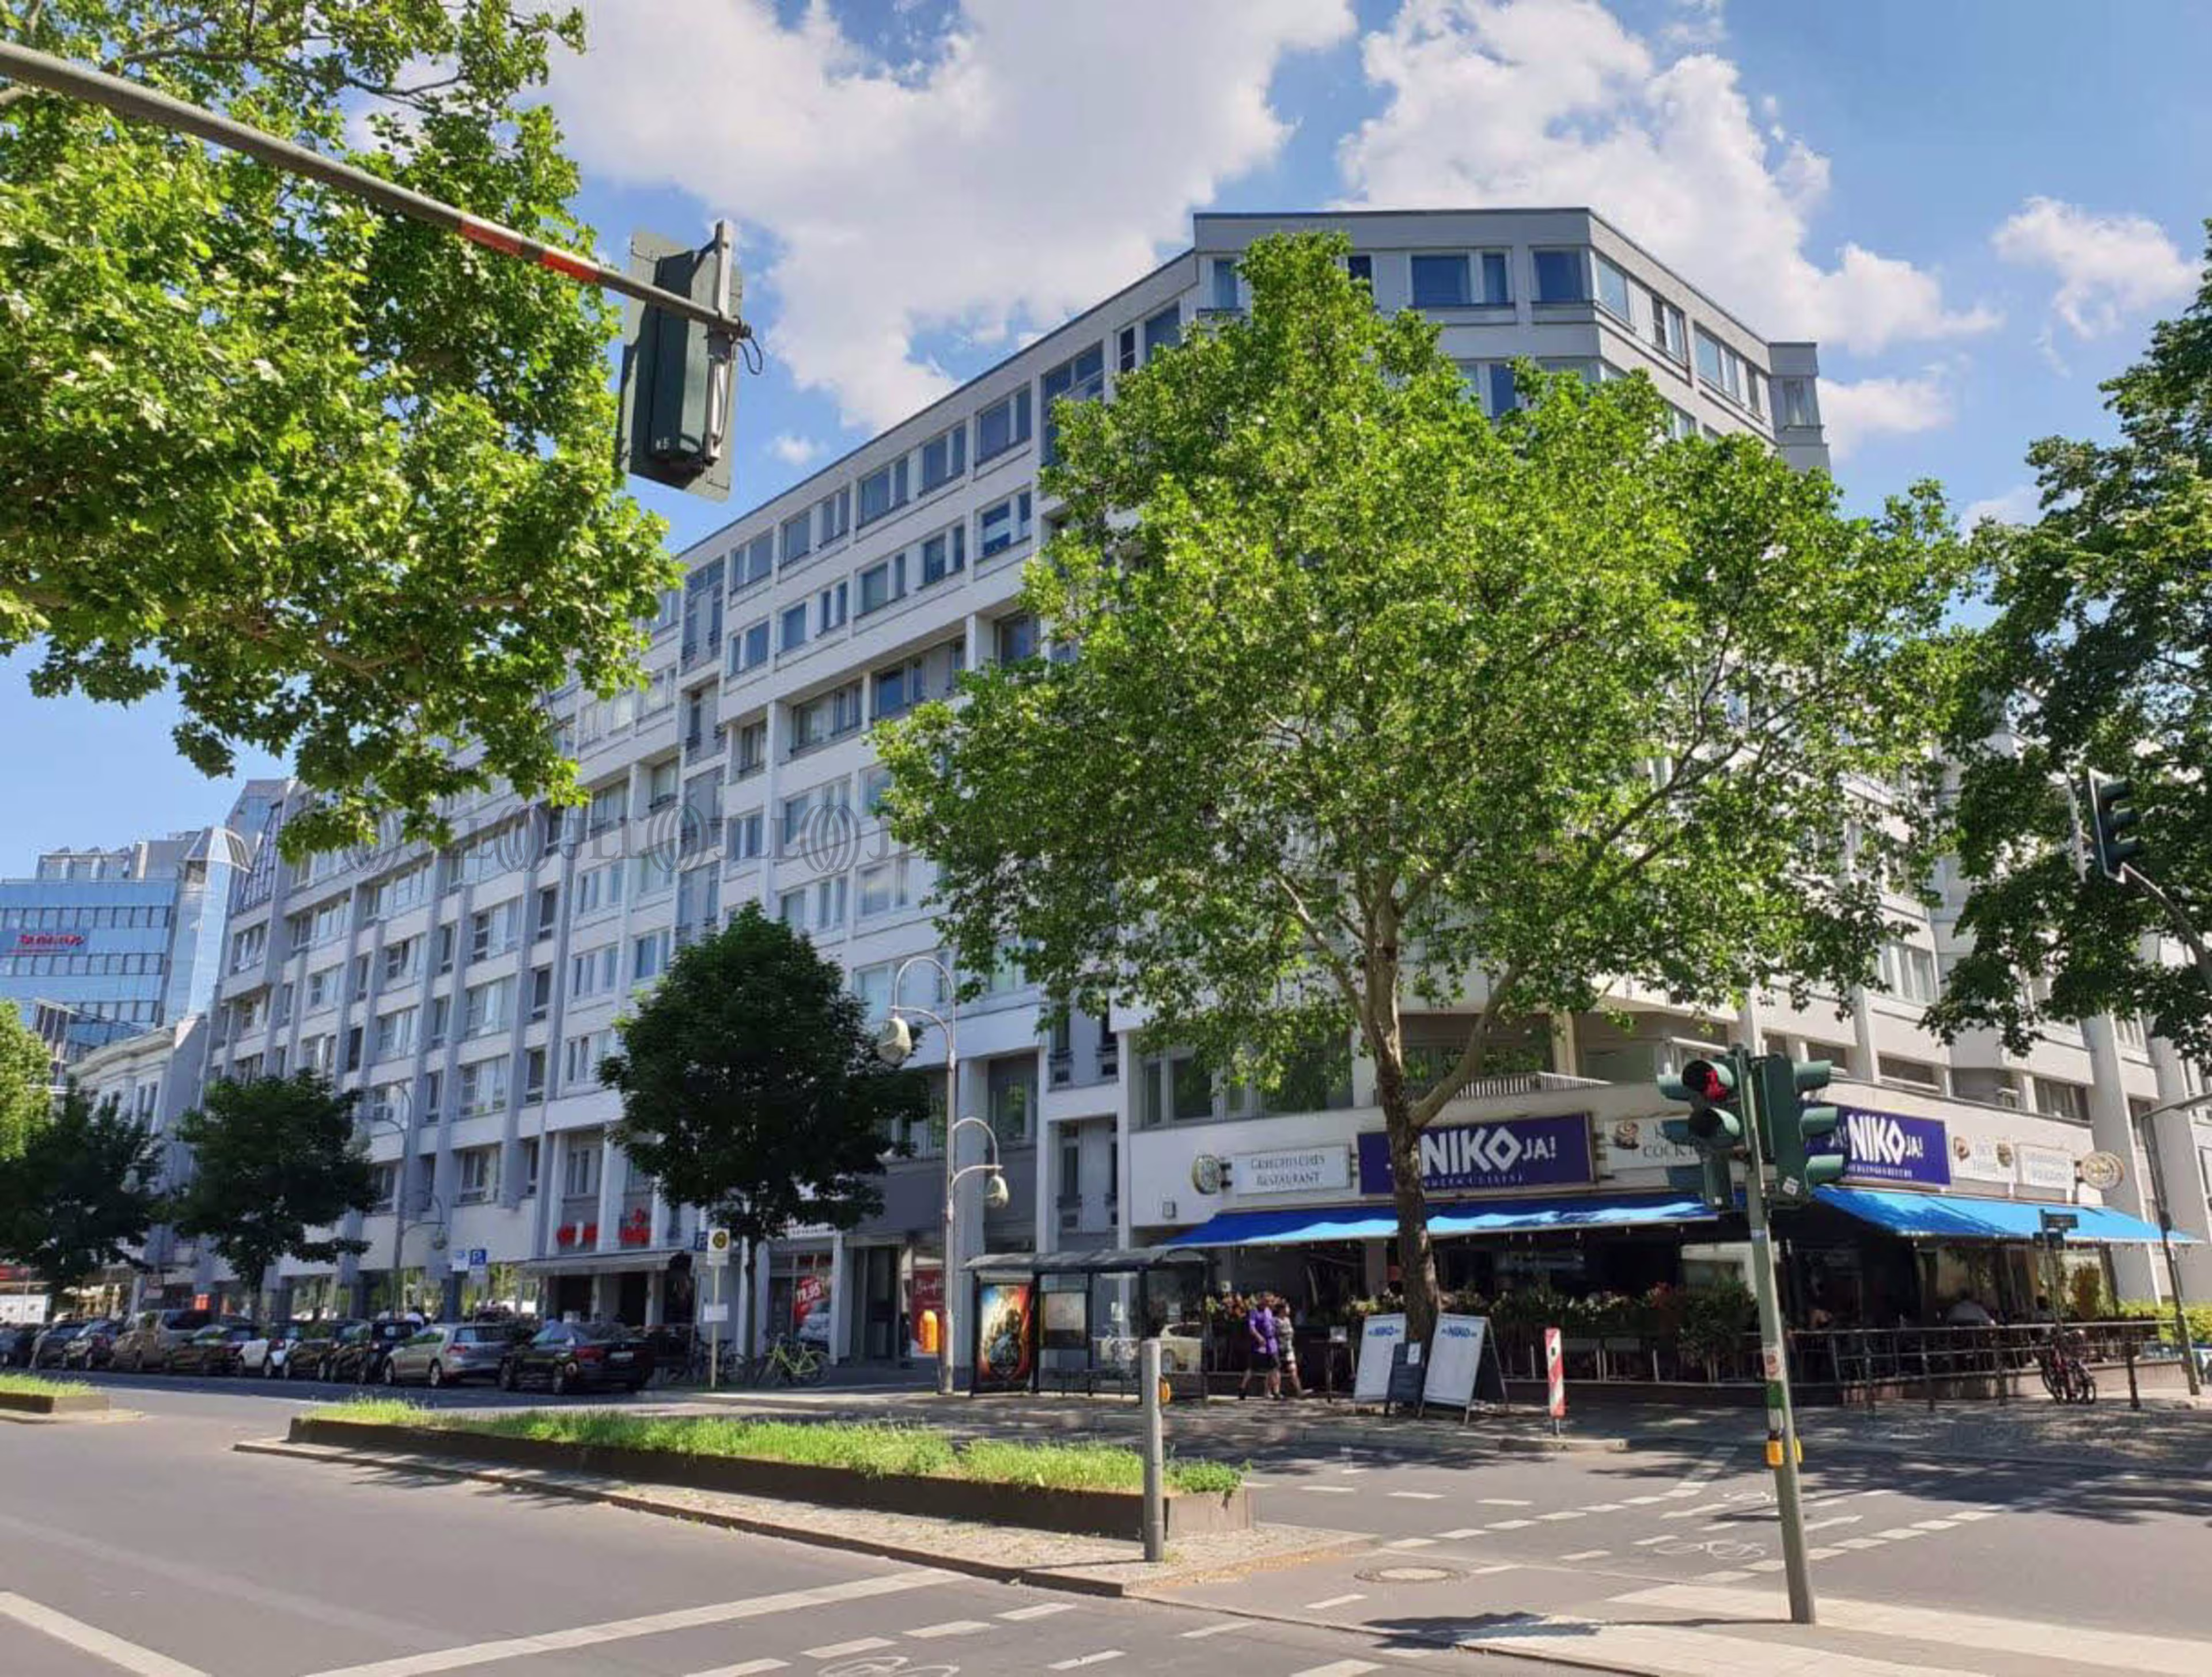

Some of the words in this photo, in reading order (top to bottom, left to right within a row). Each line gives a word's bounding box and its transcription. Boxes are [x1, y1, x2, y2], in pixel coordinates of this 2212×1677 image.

[1421, 1126, 1522, 1176] NIKO
[1522, 1136, 1556, 1161] JA!
[1847, 1114, 1905, 1165] NIKO
[1905, 1135, 1923, 1159] JA!
